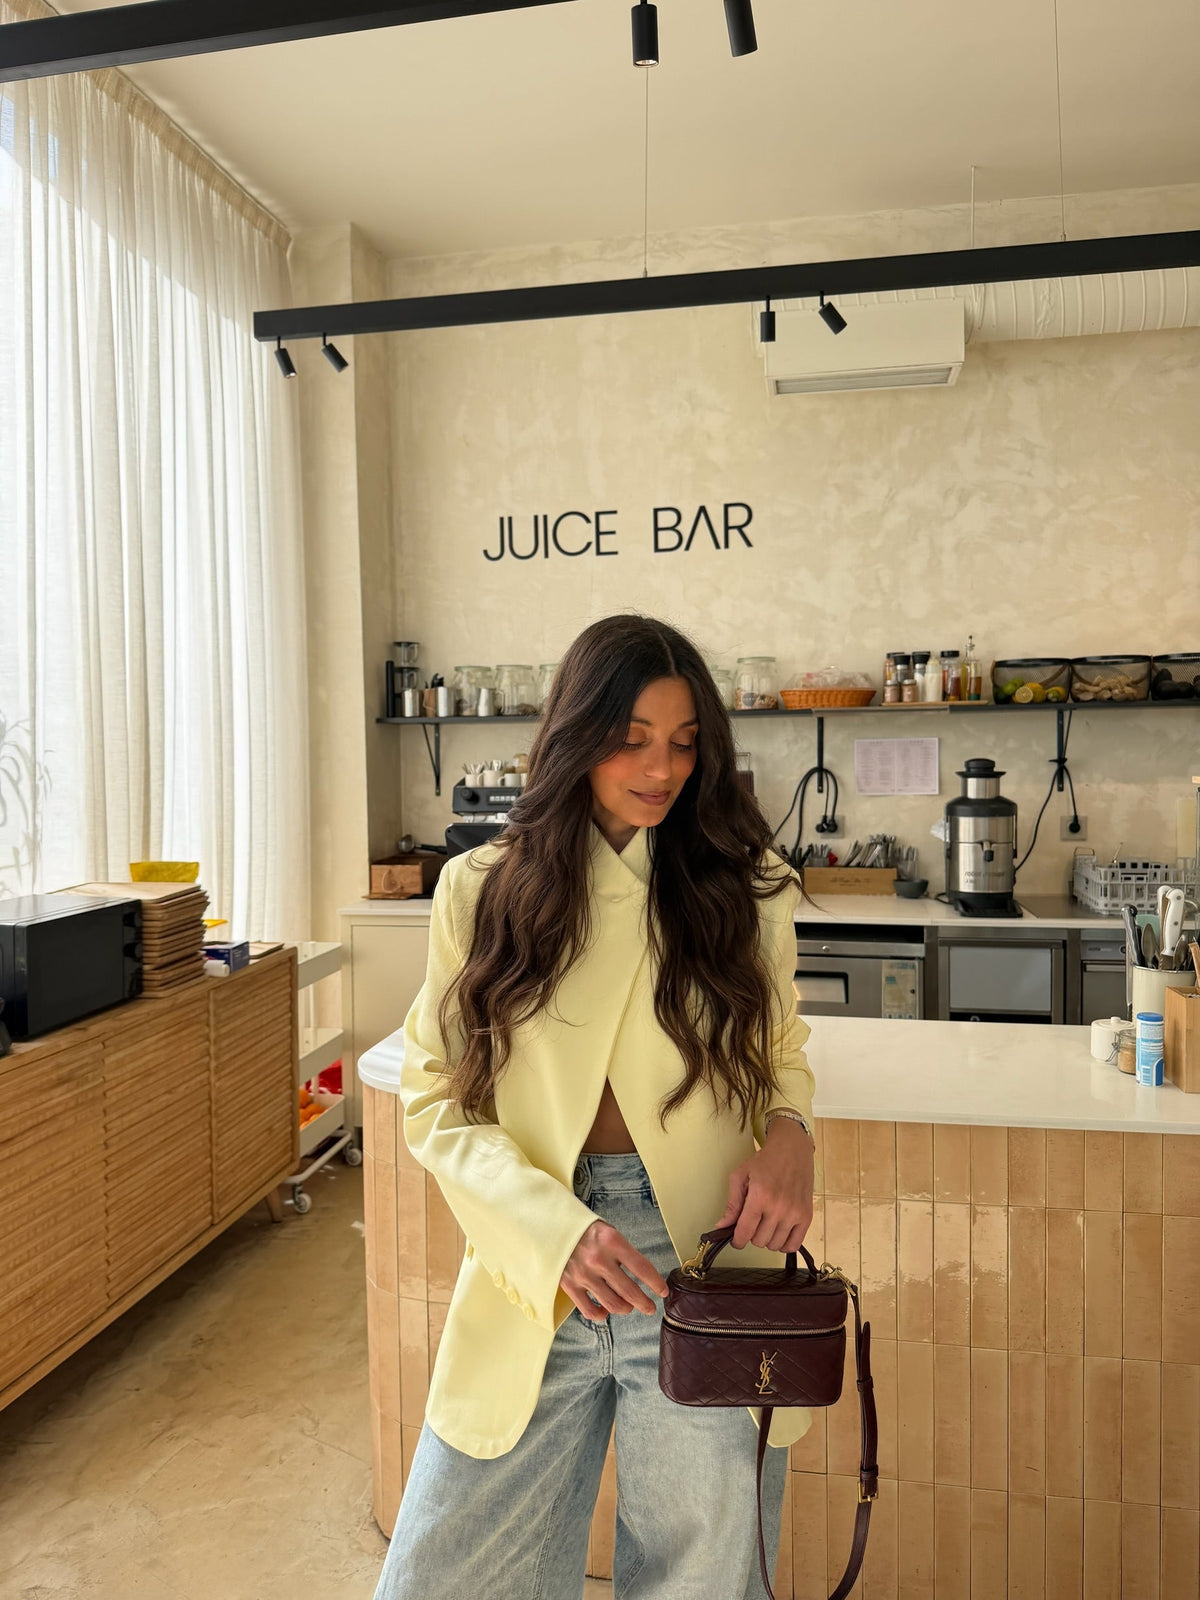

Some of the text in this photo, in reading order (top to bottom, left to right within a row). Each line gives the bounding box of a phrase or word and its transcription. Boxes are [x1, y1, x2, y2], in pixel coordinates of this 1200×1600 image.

[482, 502, 754, 562] JUICE BAR
[754, 1351, 778, 1395] YSL
